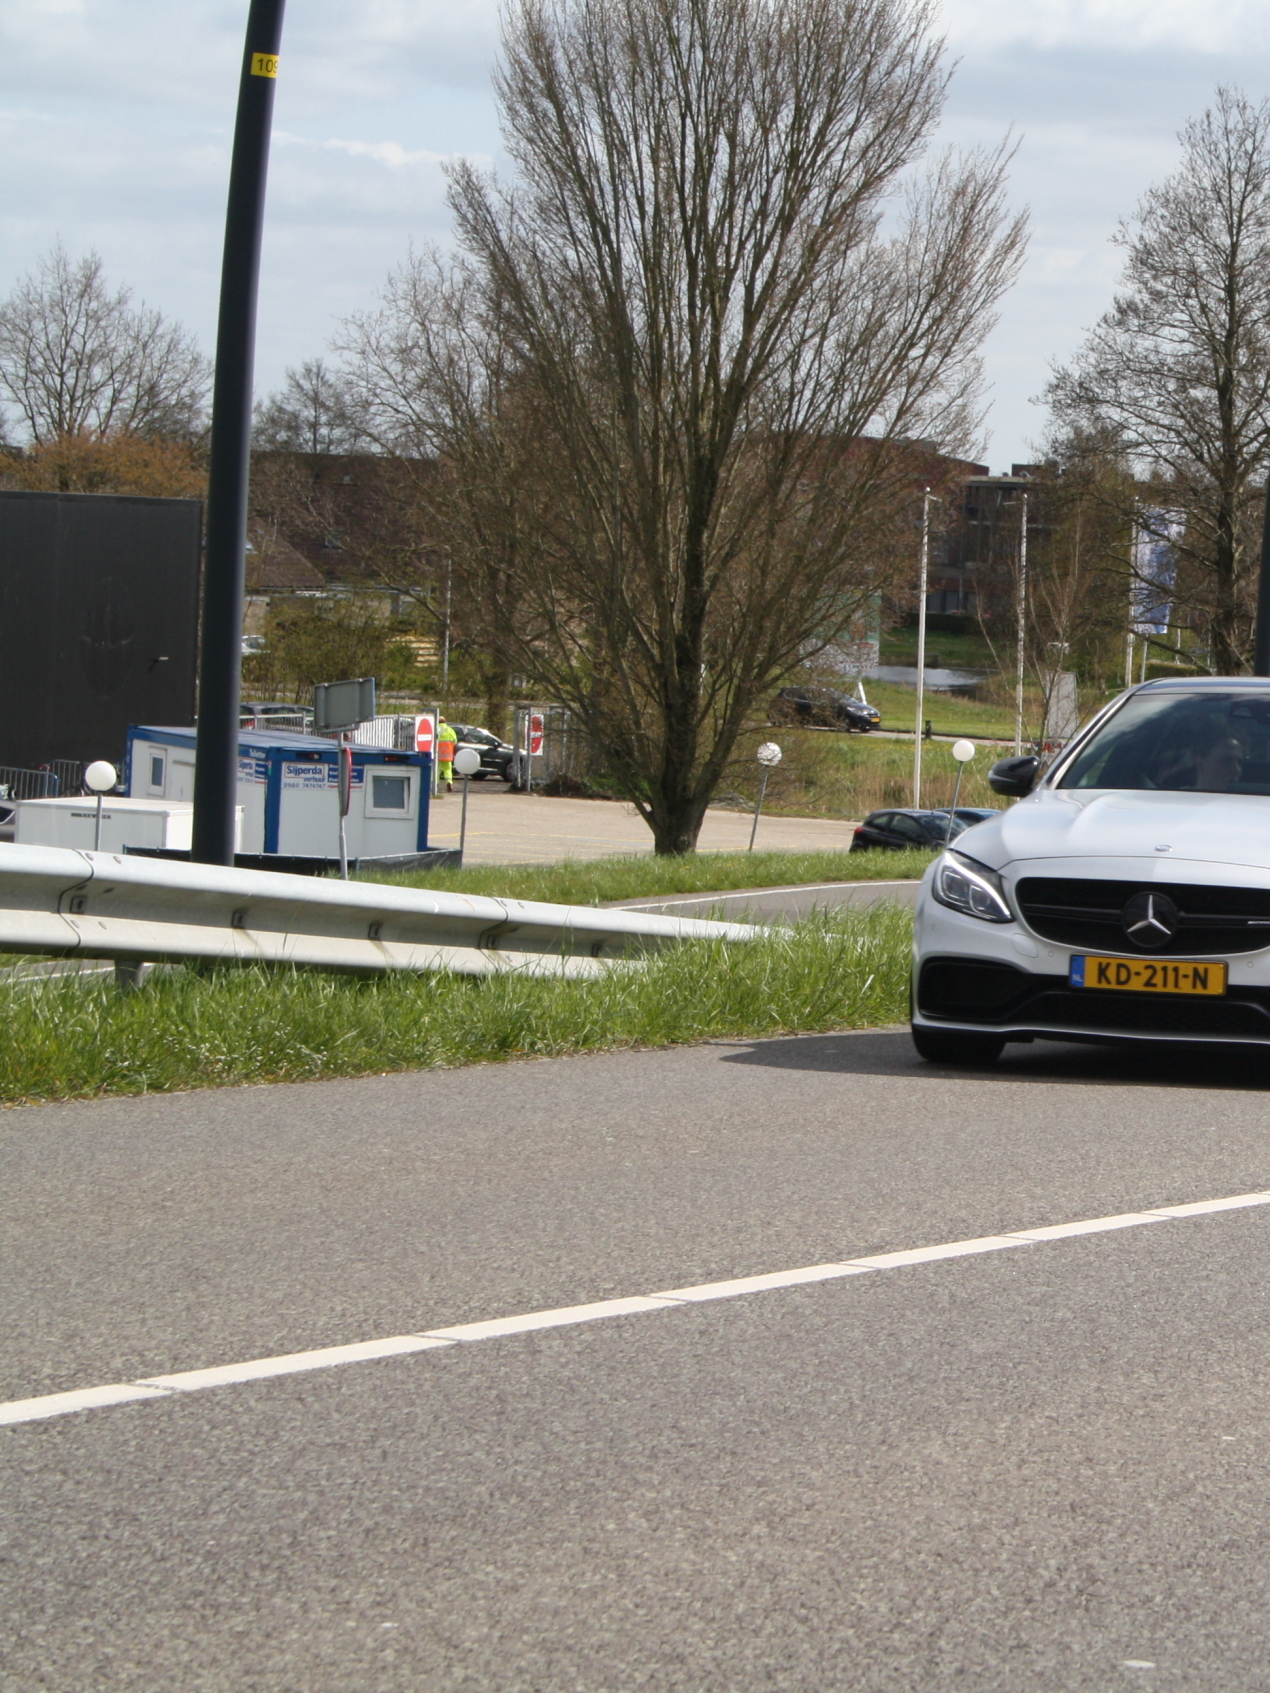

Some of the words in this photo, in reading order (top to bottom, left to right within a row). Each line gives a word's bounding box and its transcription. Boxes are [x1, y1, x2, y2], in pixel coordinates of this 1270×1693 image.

[286, 765, 323, 776] Sijperda
[1072, 973, 1083, 982] NL
[1096, 961, 1209, 990] KD-211-N
